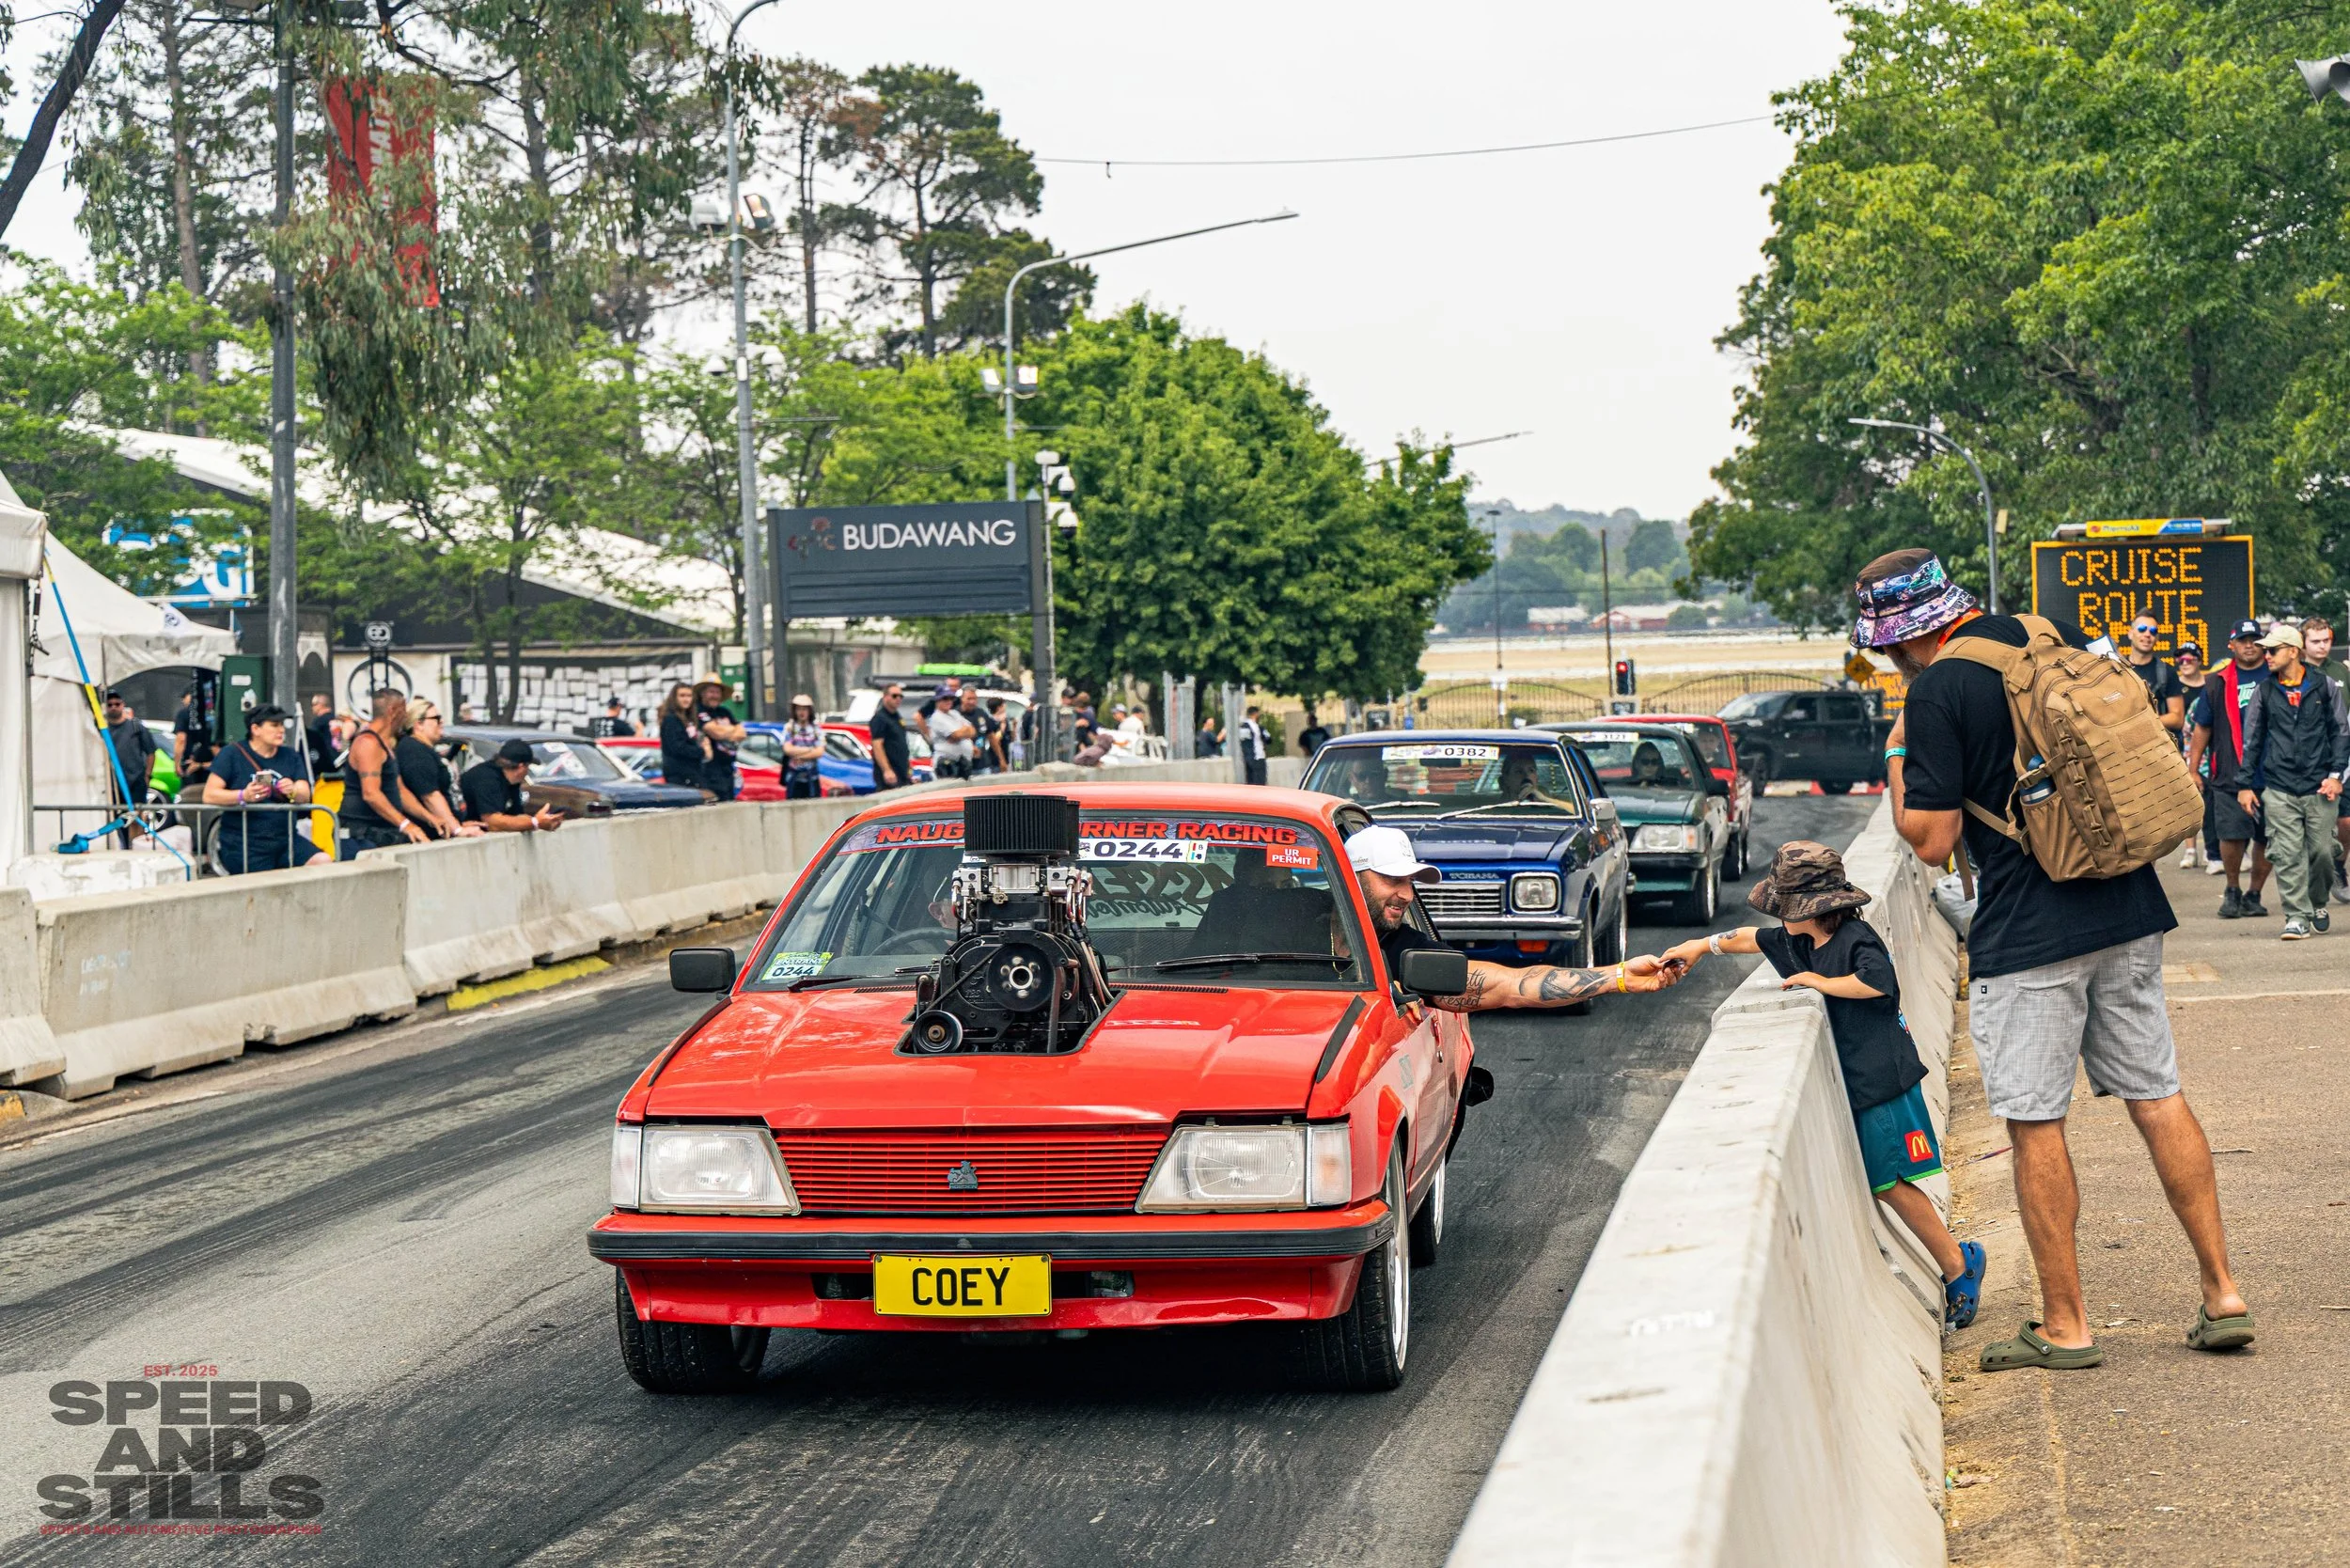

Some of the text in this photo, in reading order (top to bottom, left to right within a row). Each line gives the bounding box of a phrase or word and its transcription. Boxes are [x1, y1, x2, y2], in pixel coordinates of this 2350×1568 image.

[842, 519, 1017, 551] BUDAWANG
[2060, 546, 2203, 587] CRUISE
[1444, 747, 1487, 757] 0382
[876, 823, 965, 845] NAUG
[1175, 822, 1299, 845] RACING
[1093, 840, 1183, 859] 0244
[1284, 848, 1301, 857] UR
[1271, 855, 1313, 866] PERMIT
[772, 966, 815, 977] 0244
[911, 1266, 1011, 1307] COEY
